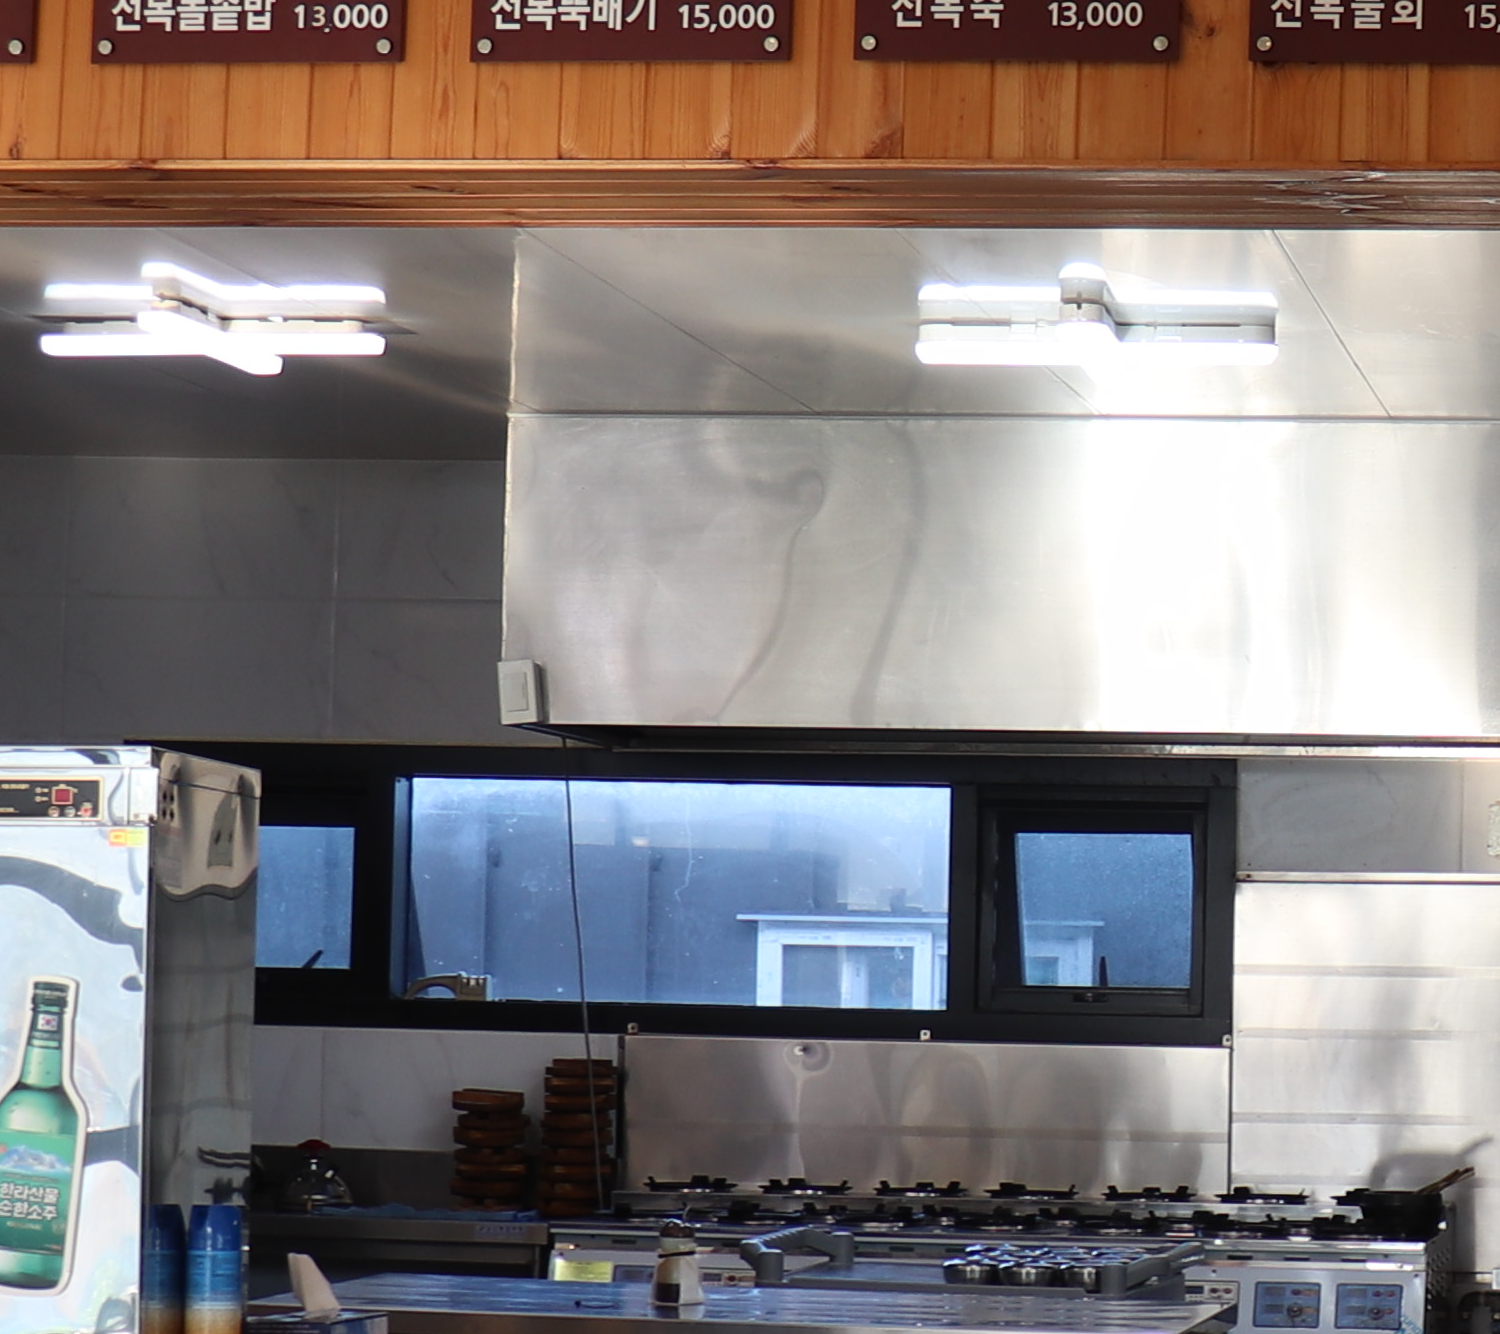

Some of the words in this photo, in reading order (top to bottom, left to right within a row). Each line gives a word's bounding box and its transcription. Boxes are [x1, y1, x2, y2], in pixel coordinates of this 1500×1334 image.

[294, 3, 389, 33] 13,000
[677, 4, 776, 33] 15,000
[1047, 1, 1143, 32] 13,000
[0, 1183, 59, 1203] 한라산물
